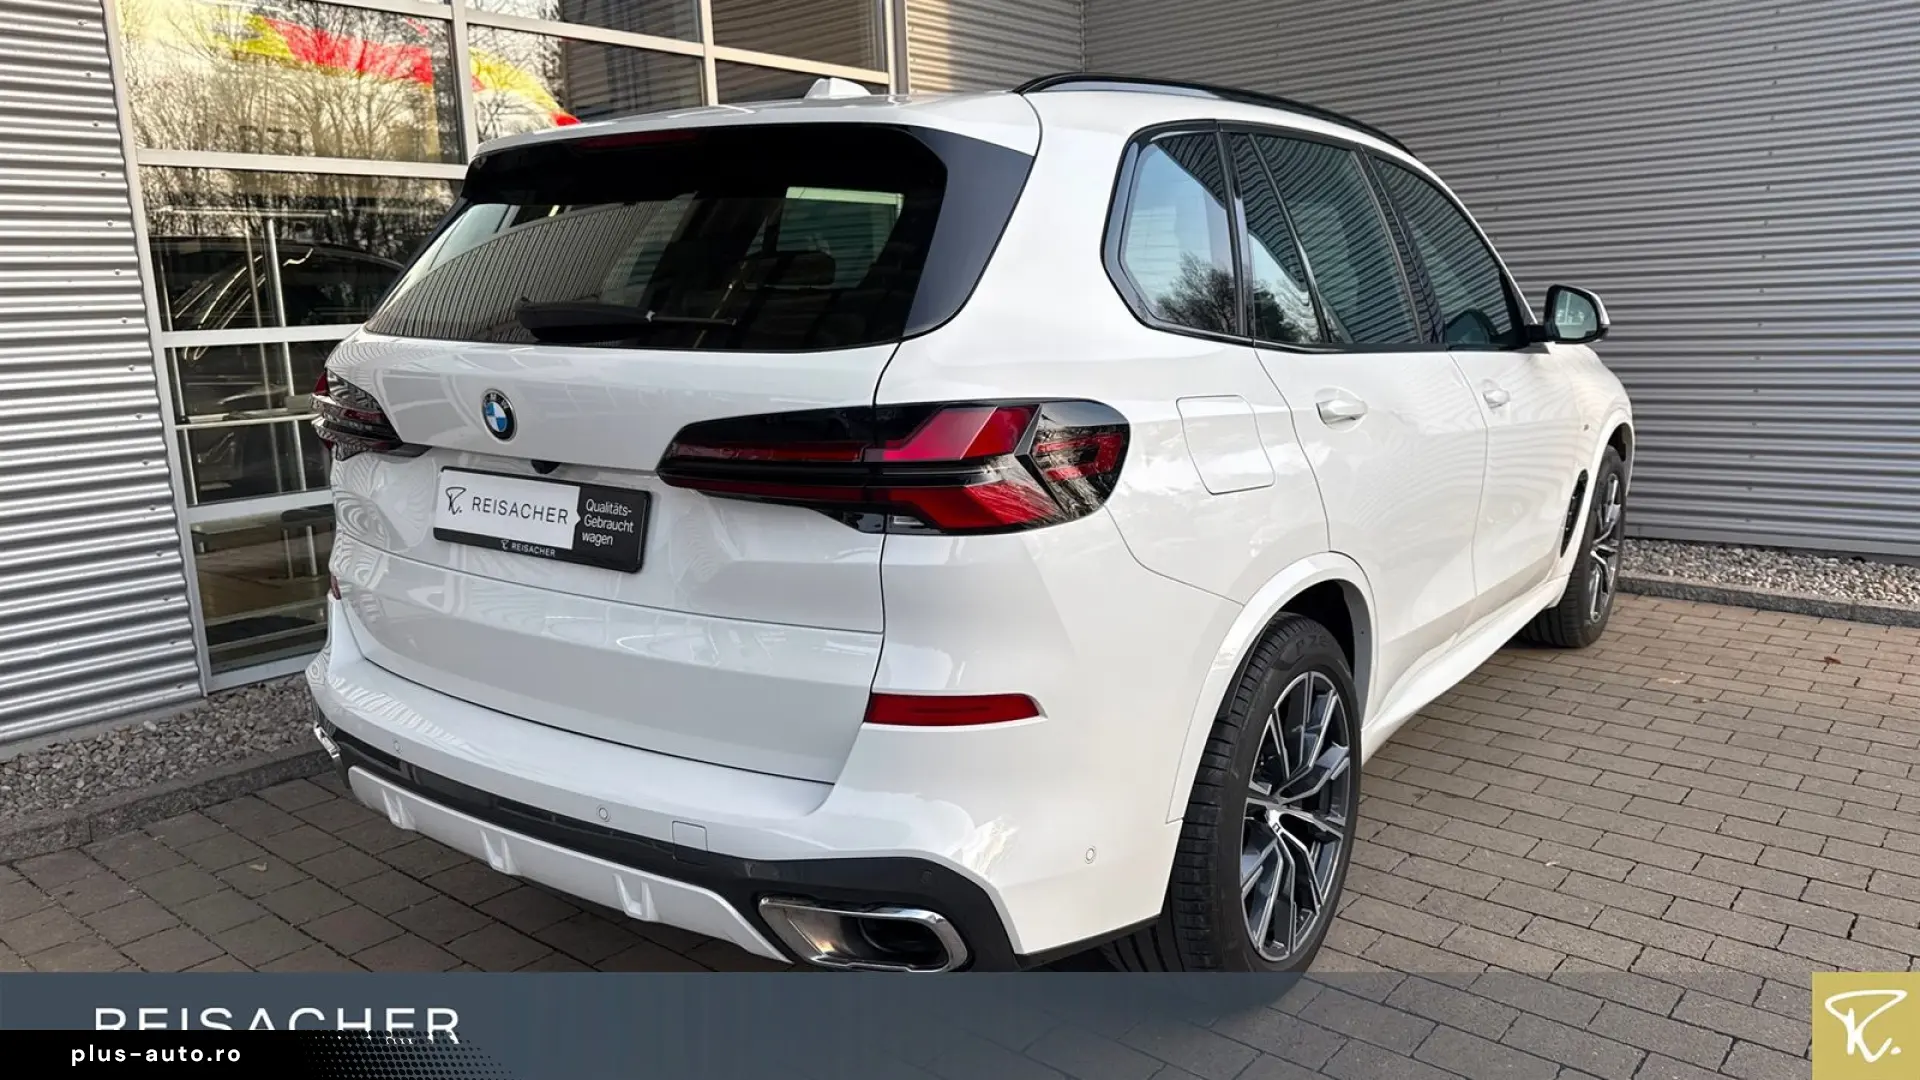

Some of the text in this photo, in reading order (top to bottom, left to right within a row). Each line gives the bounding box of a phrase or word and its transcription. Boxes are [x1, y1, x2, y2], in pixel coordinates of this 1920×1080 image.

[472, 496, 569, 525] REISACHER
[586, 498, 632, 517] Qualitäts-
[583, 513, 635, 534] Gebraucht
[581, 531, 614, 547] wagen
[511, 542, 556, 558] REISACHER
